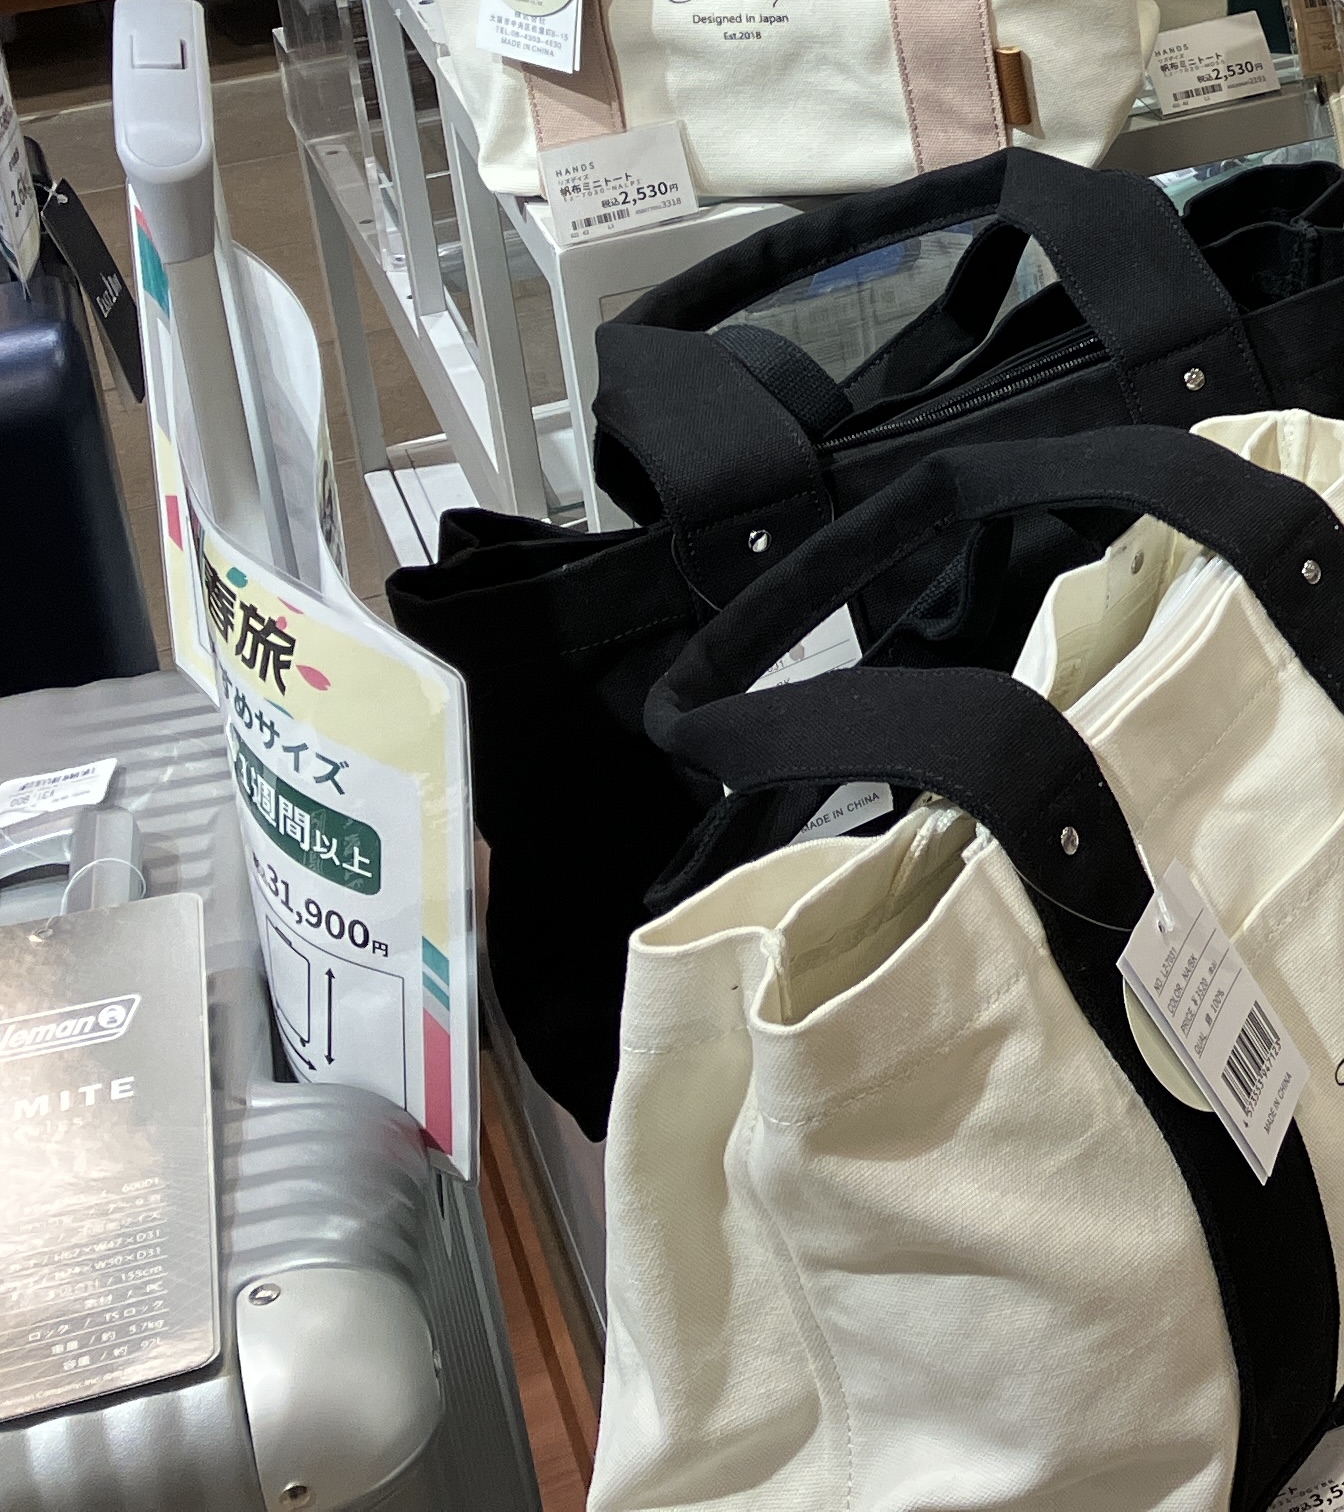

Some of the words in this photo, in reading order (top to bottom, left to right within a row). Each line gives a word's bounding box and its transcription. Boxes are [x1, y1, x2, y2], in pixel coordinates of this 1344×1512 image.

[692, 13, 742, 27] Designed
[760, 12, 789, 26] Japan
[1154, 43, 1190, 58] HANDS
[1197, 60, 1264, 83] 税込2,530円
[555, 161, 595, 178] HANDS
[560, 172, 633, 197] 帆布ミニトート
[601, 181, 679, 208] 税込2,530円
[202, 575, 297, 696] 春旅
[223, 678, 352, 796] めサイズ
[0, 1013, 98, 1050] leman
